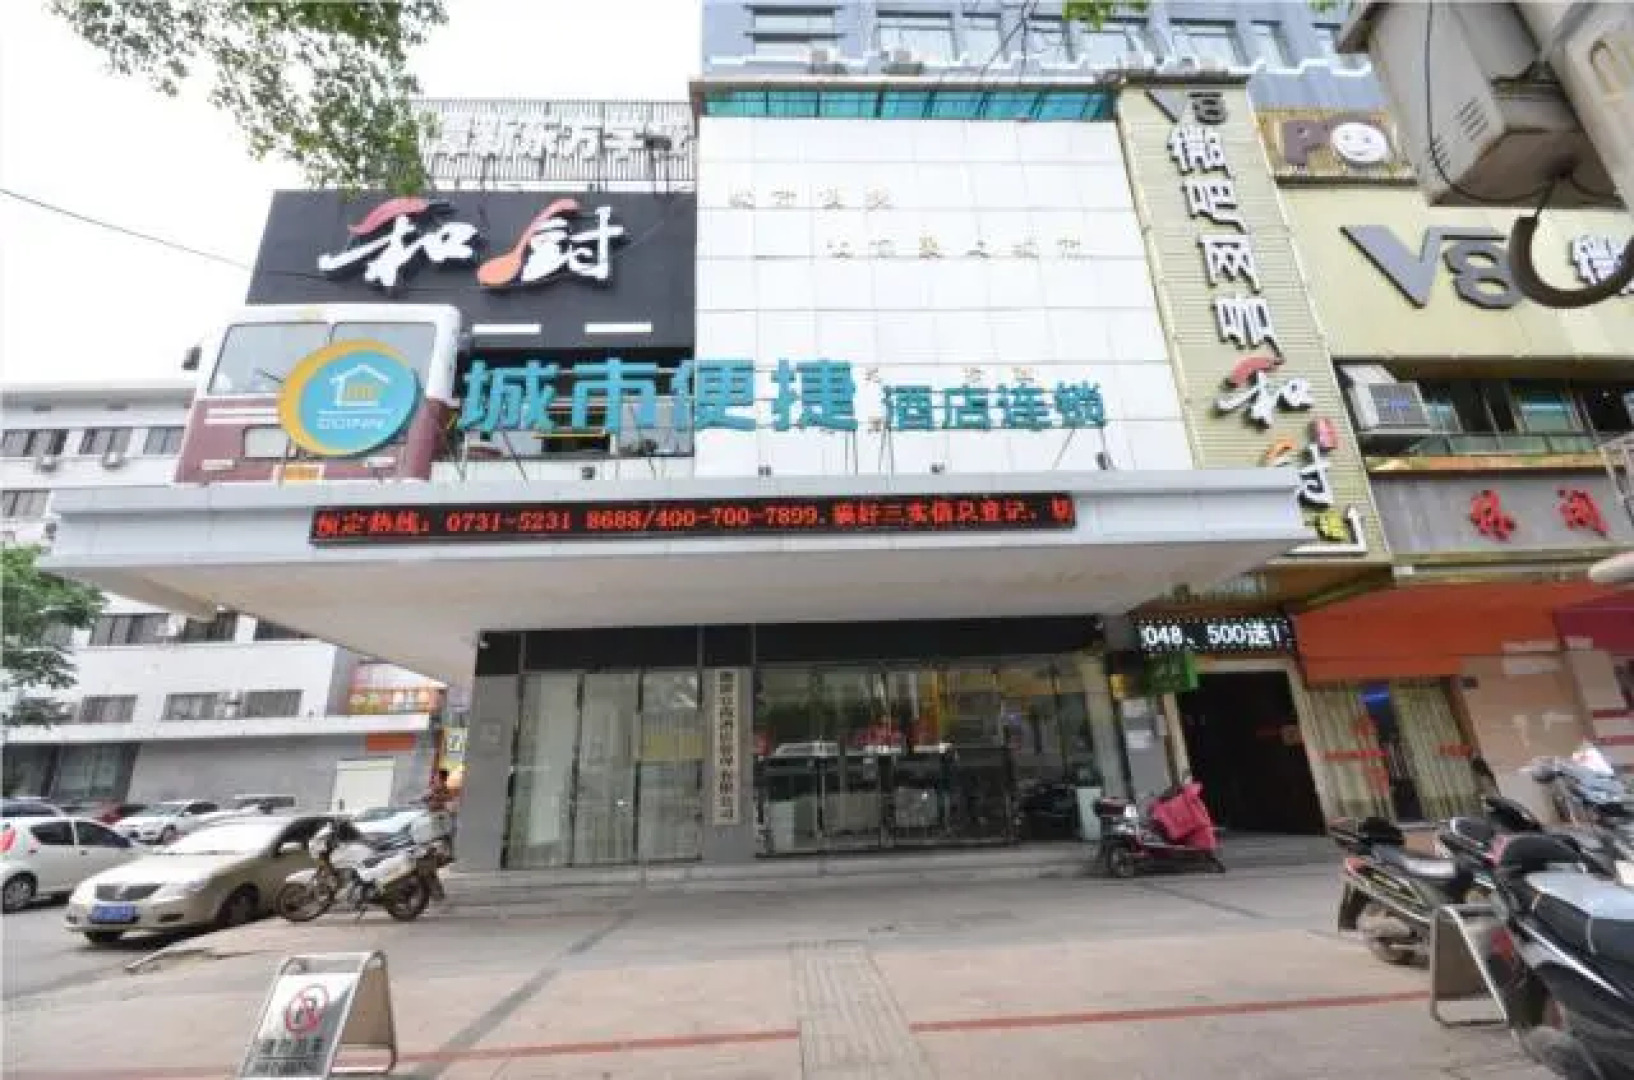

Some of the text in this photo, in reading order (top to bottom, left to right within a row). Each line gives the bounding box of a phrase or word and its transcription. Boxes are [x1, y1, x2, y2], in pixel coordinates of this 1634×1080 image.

[1341, 226, 1523, 308] V8
[459, 358, 1105, 433] 城市便捷 酒店连锁
